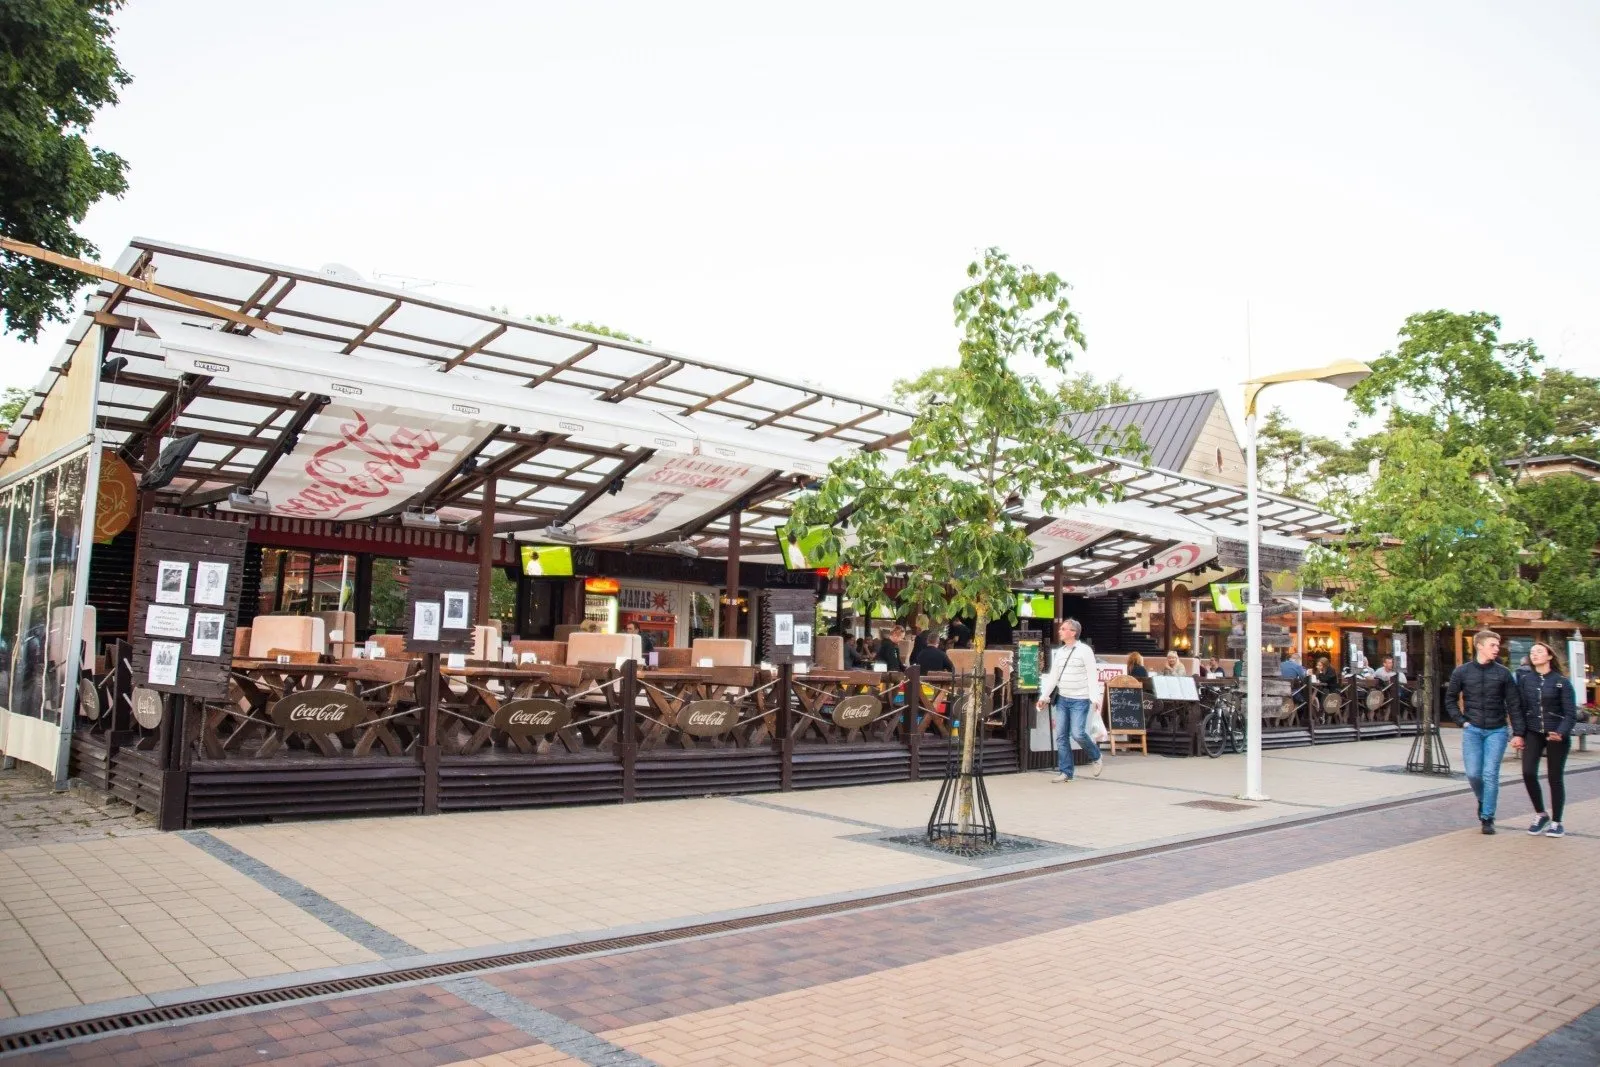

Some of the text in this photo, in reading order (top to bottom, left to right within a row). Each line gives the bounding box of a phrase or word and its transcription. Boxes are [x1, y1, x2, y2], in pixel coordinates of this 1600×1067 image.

[290, 703, 348, 721] Coca-Cola
[508, 709, 557, 725] Coca-Cola
[688, 710, 727, 726] Coca-Cola
